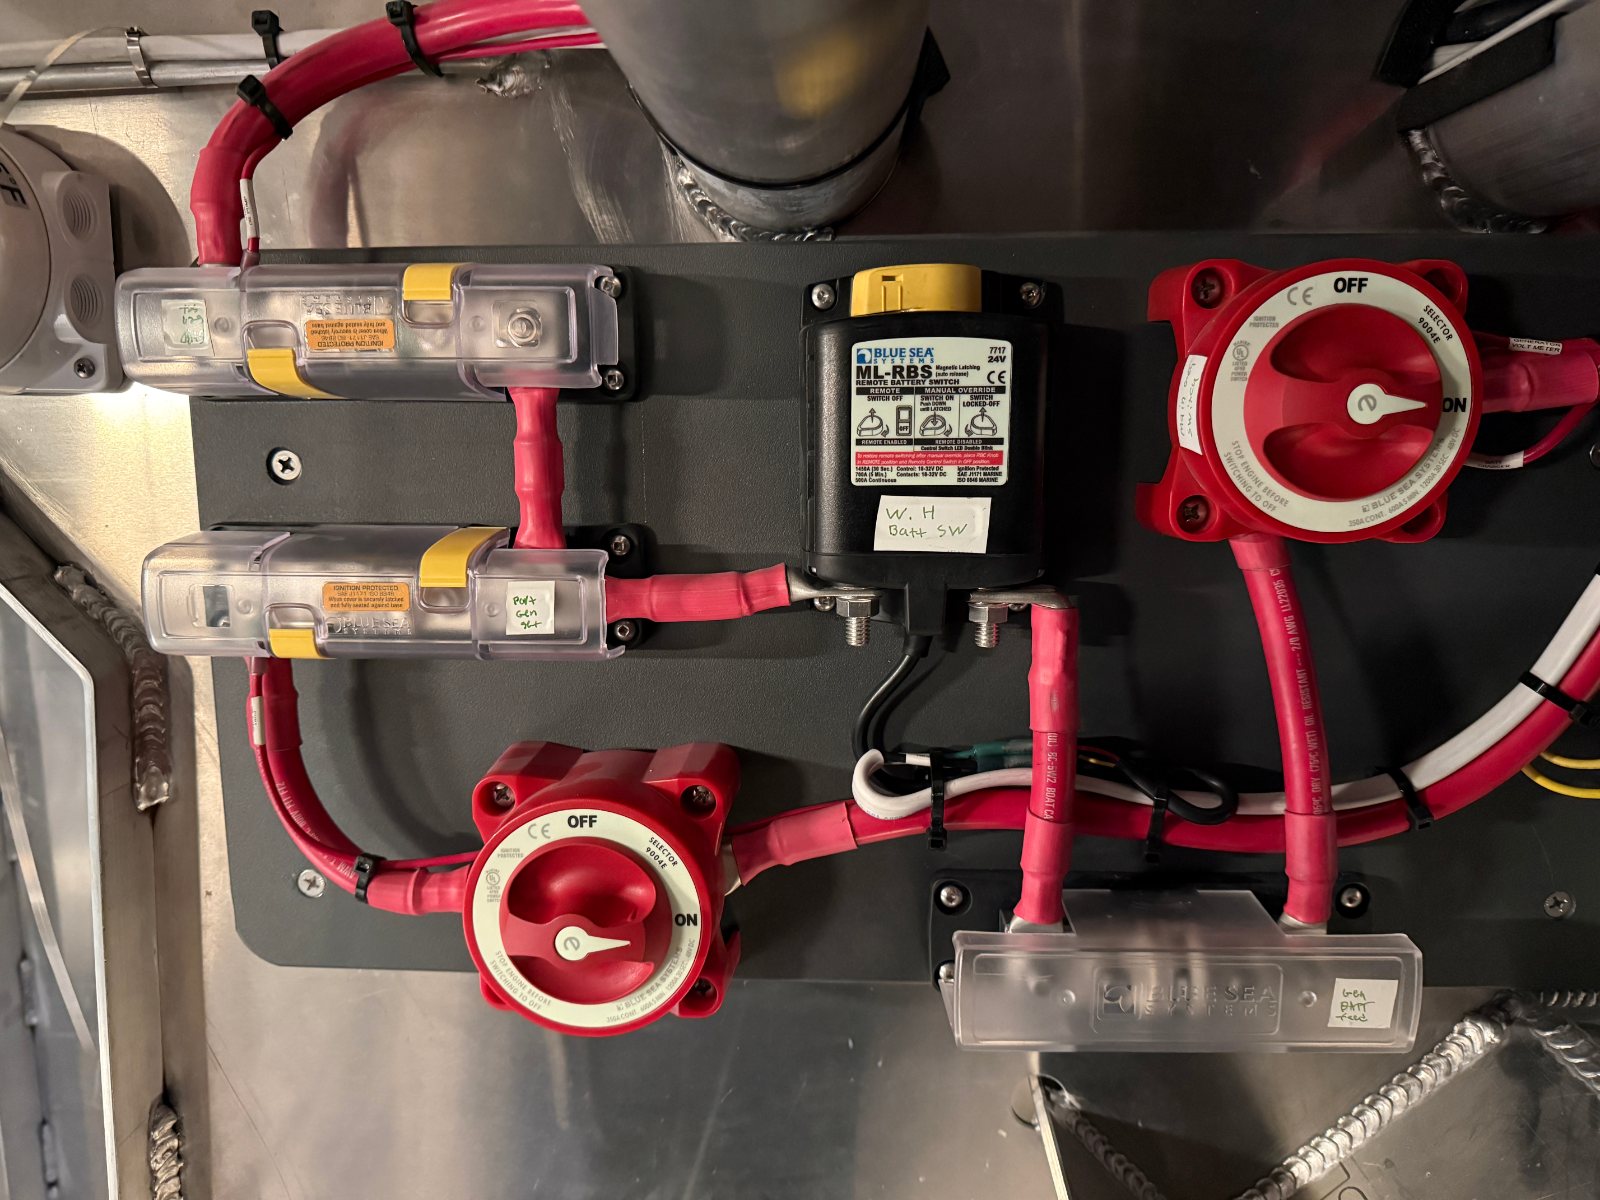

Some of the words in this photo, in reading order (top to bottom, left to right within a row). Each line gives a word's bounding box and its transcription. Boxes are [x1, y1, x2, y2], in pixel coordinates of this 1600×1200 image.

[1334, 277, 1368, 293] OFF
[1418, 317, 1441, 344] 9004E
[1423, 305, 1453, 340] SELECTOR
[874, 348, 906, 357] BLUE
[909, 348, 934, 357] SEA
[856, 366, 932, 379] ML-RBS
[1442, 397, 1467, 412] ON
[1224, 452, 1252, 493] SWITCHING
[1251, 490, 1261, 502] TO
[1262, 500, 1279, 511] OFF
[1232, 440, 1245, 462] STOP
[1241, 458, 1263, 488] ENGINE
[1262, 485, 1289, 507] BEFORE
[1371, 491, 1397, 509] BLUE
[1395, 480, 1415, 495] SEA
[1414, 438, 1444, 479] SYSTEMS
[923, 505, 935, 519] H
[937, 523, 968, 538] SW
[1273, 580, 1292, 612] LL22035
[1284, 615, 1299, 635] AWG
[1289, 637, 1302, 651] 2/0
[1295, 669, 1312, 710] RESISTANT
[1304, 713, 1315, 726] OIL
[1047, 733, 1058, 747] (UL)
[1311, 778, 1322, 793] DRY
[1044, 787, 1056, 808] BOAT
[568, 815, 597, 828] OFF
[646, 847, 668, 869] 9004E
[649, 837, 678, 867] SELECTOR
[675, 914, 697, 926] ON
[506, 967, 527, 991] ENGINE
[625, 993, 647, 1008] BLUE
[1224, 985, 1277, 1002] SEA
